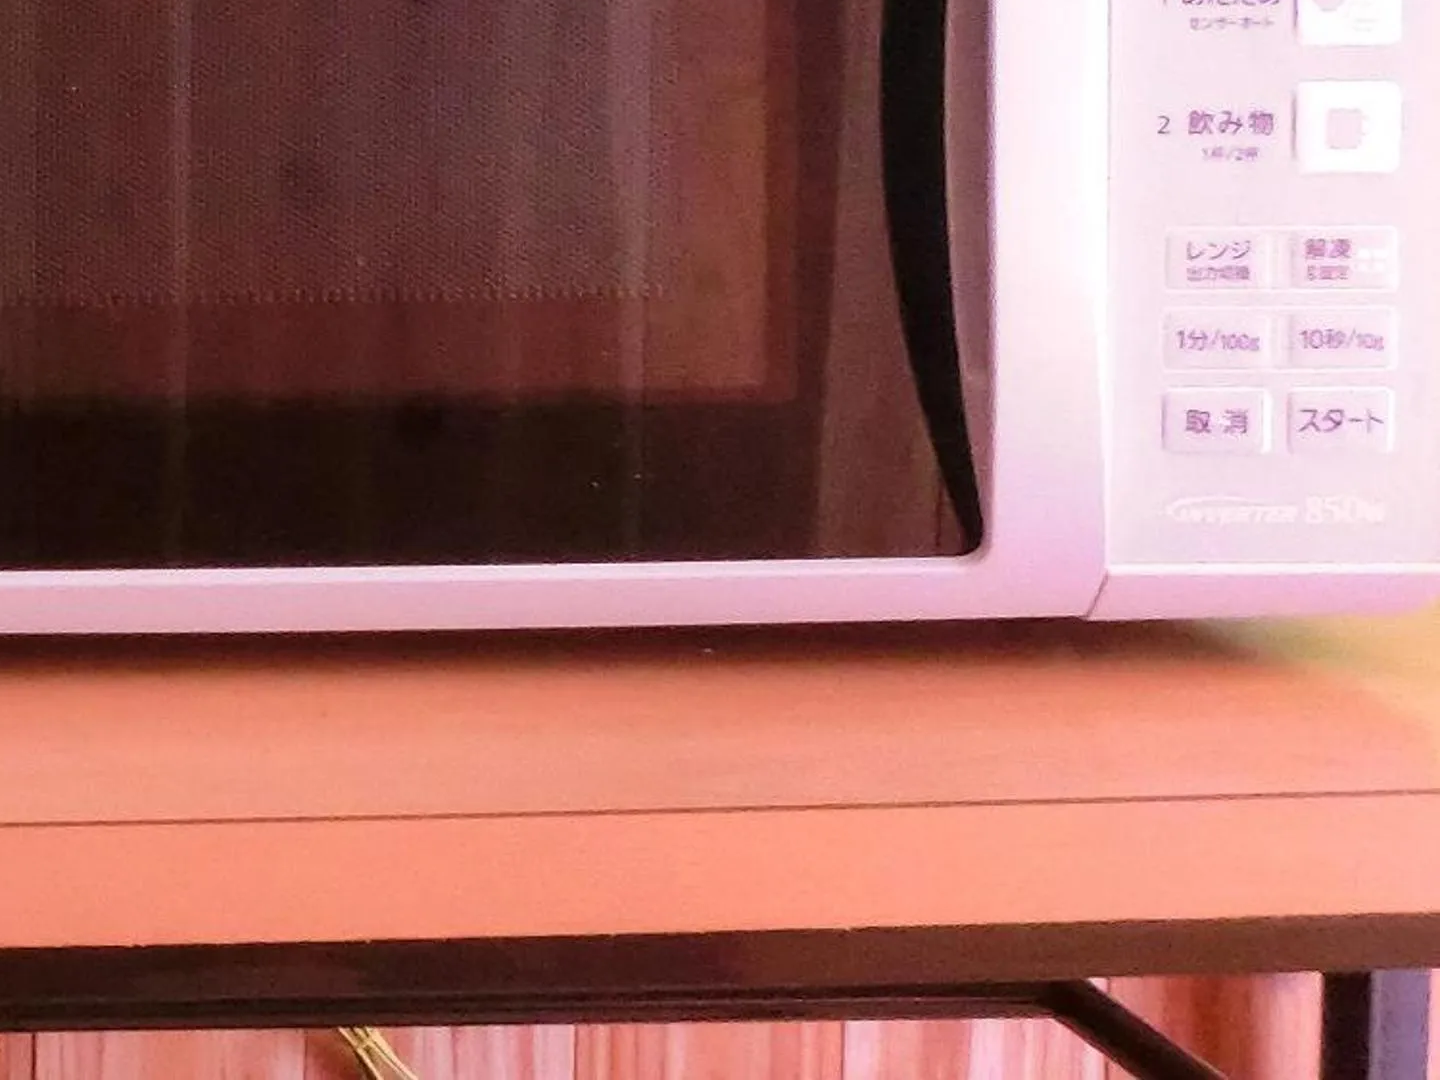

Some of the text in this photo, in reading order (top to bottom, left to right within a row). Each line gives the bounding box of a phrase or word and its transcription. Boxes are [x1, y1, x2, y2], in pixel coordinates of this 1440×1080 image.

[1157, 109, 1274, 136] 2 飲み物
[1186, 240, 1252, 261] レンジ
[1298, 408, 1385, 434] スタート
